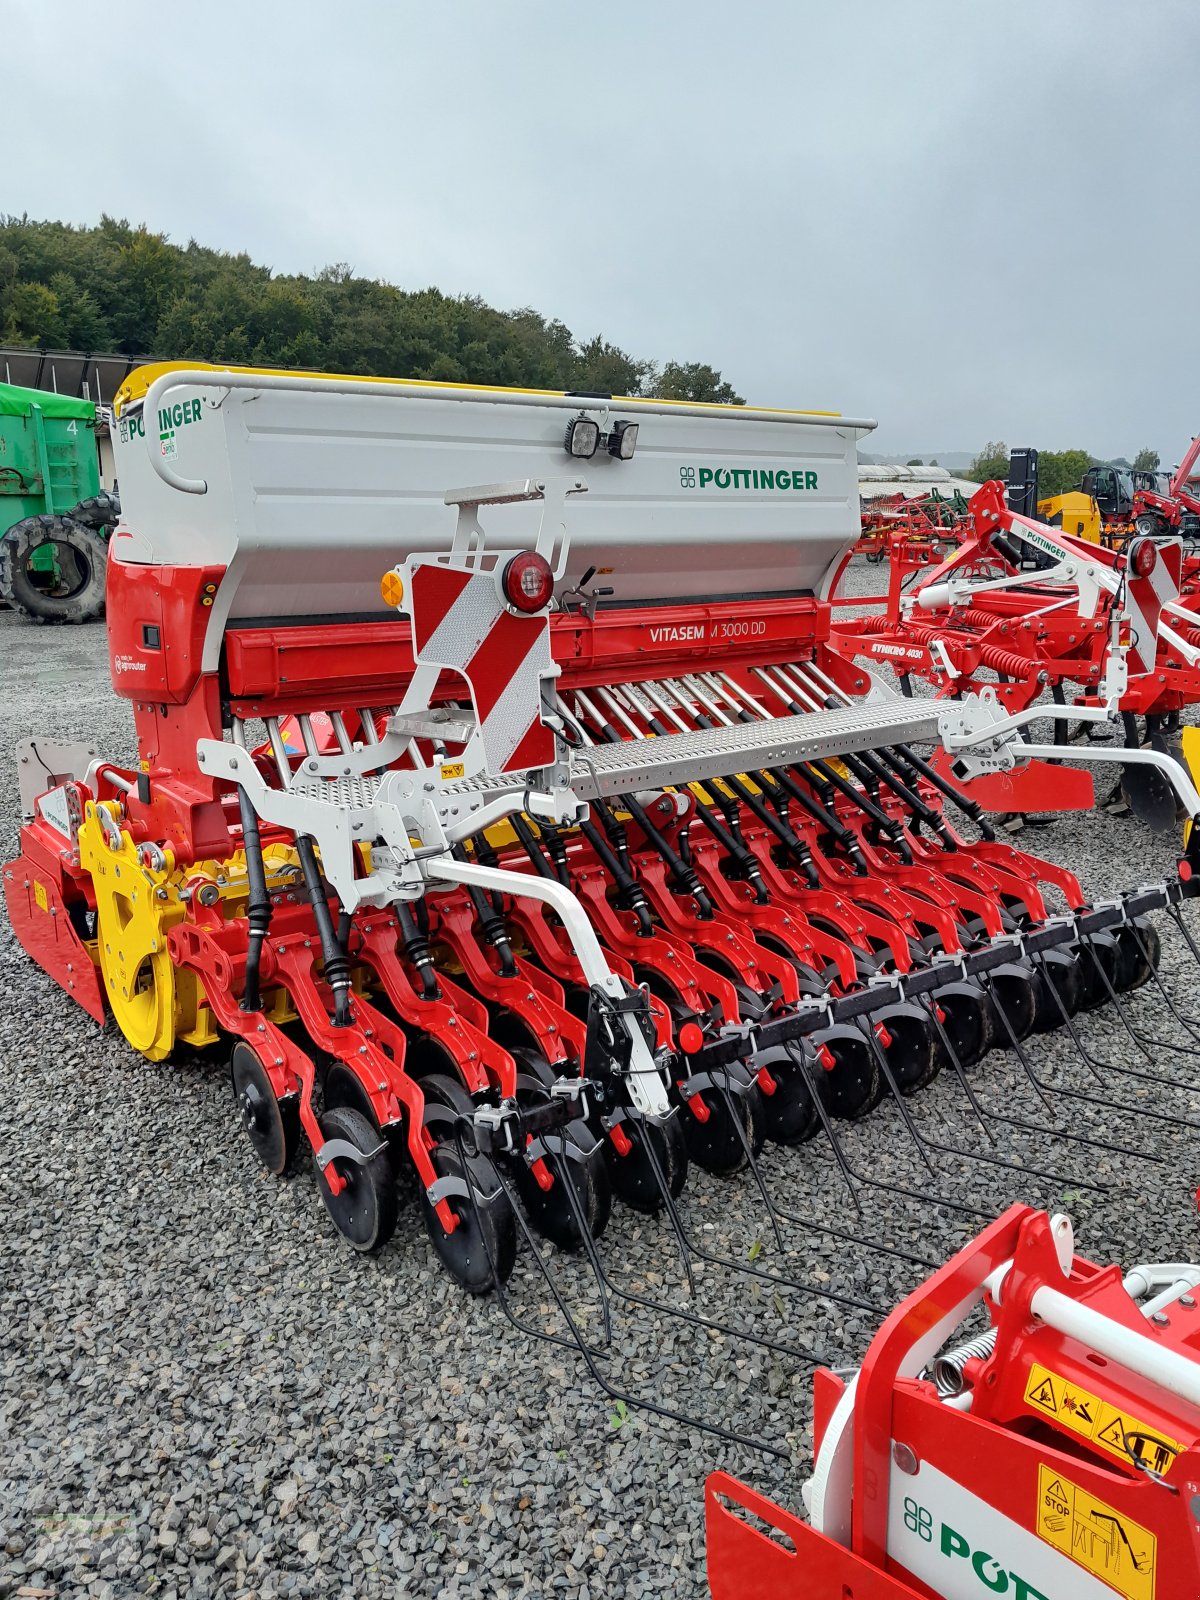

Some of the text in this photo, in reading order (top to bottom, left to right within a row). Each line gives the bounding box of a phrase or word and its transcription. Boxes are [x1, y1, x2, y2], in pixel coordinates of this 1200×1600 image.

[66, 419, 79, 436] 4
[698, 467, 819, 490] PÖTTINGER
[650, 625, 705, 643] VITASEM
[721, 622, 749, 638] 3000
[751, 621, 766, 635] DD
[871, 643, 906, 656] SYNKRO
[1045, 1495, 1070, 1517] STOP
[941, 1522, 1050, 1600] PÖT
